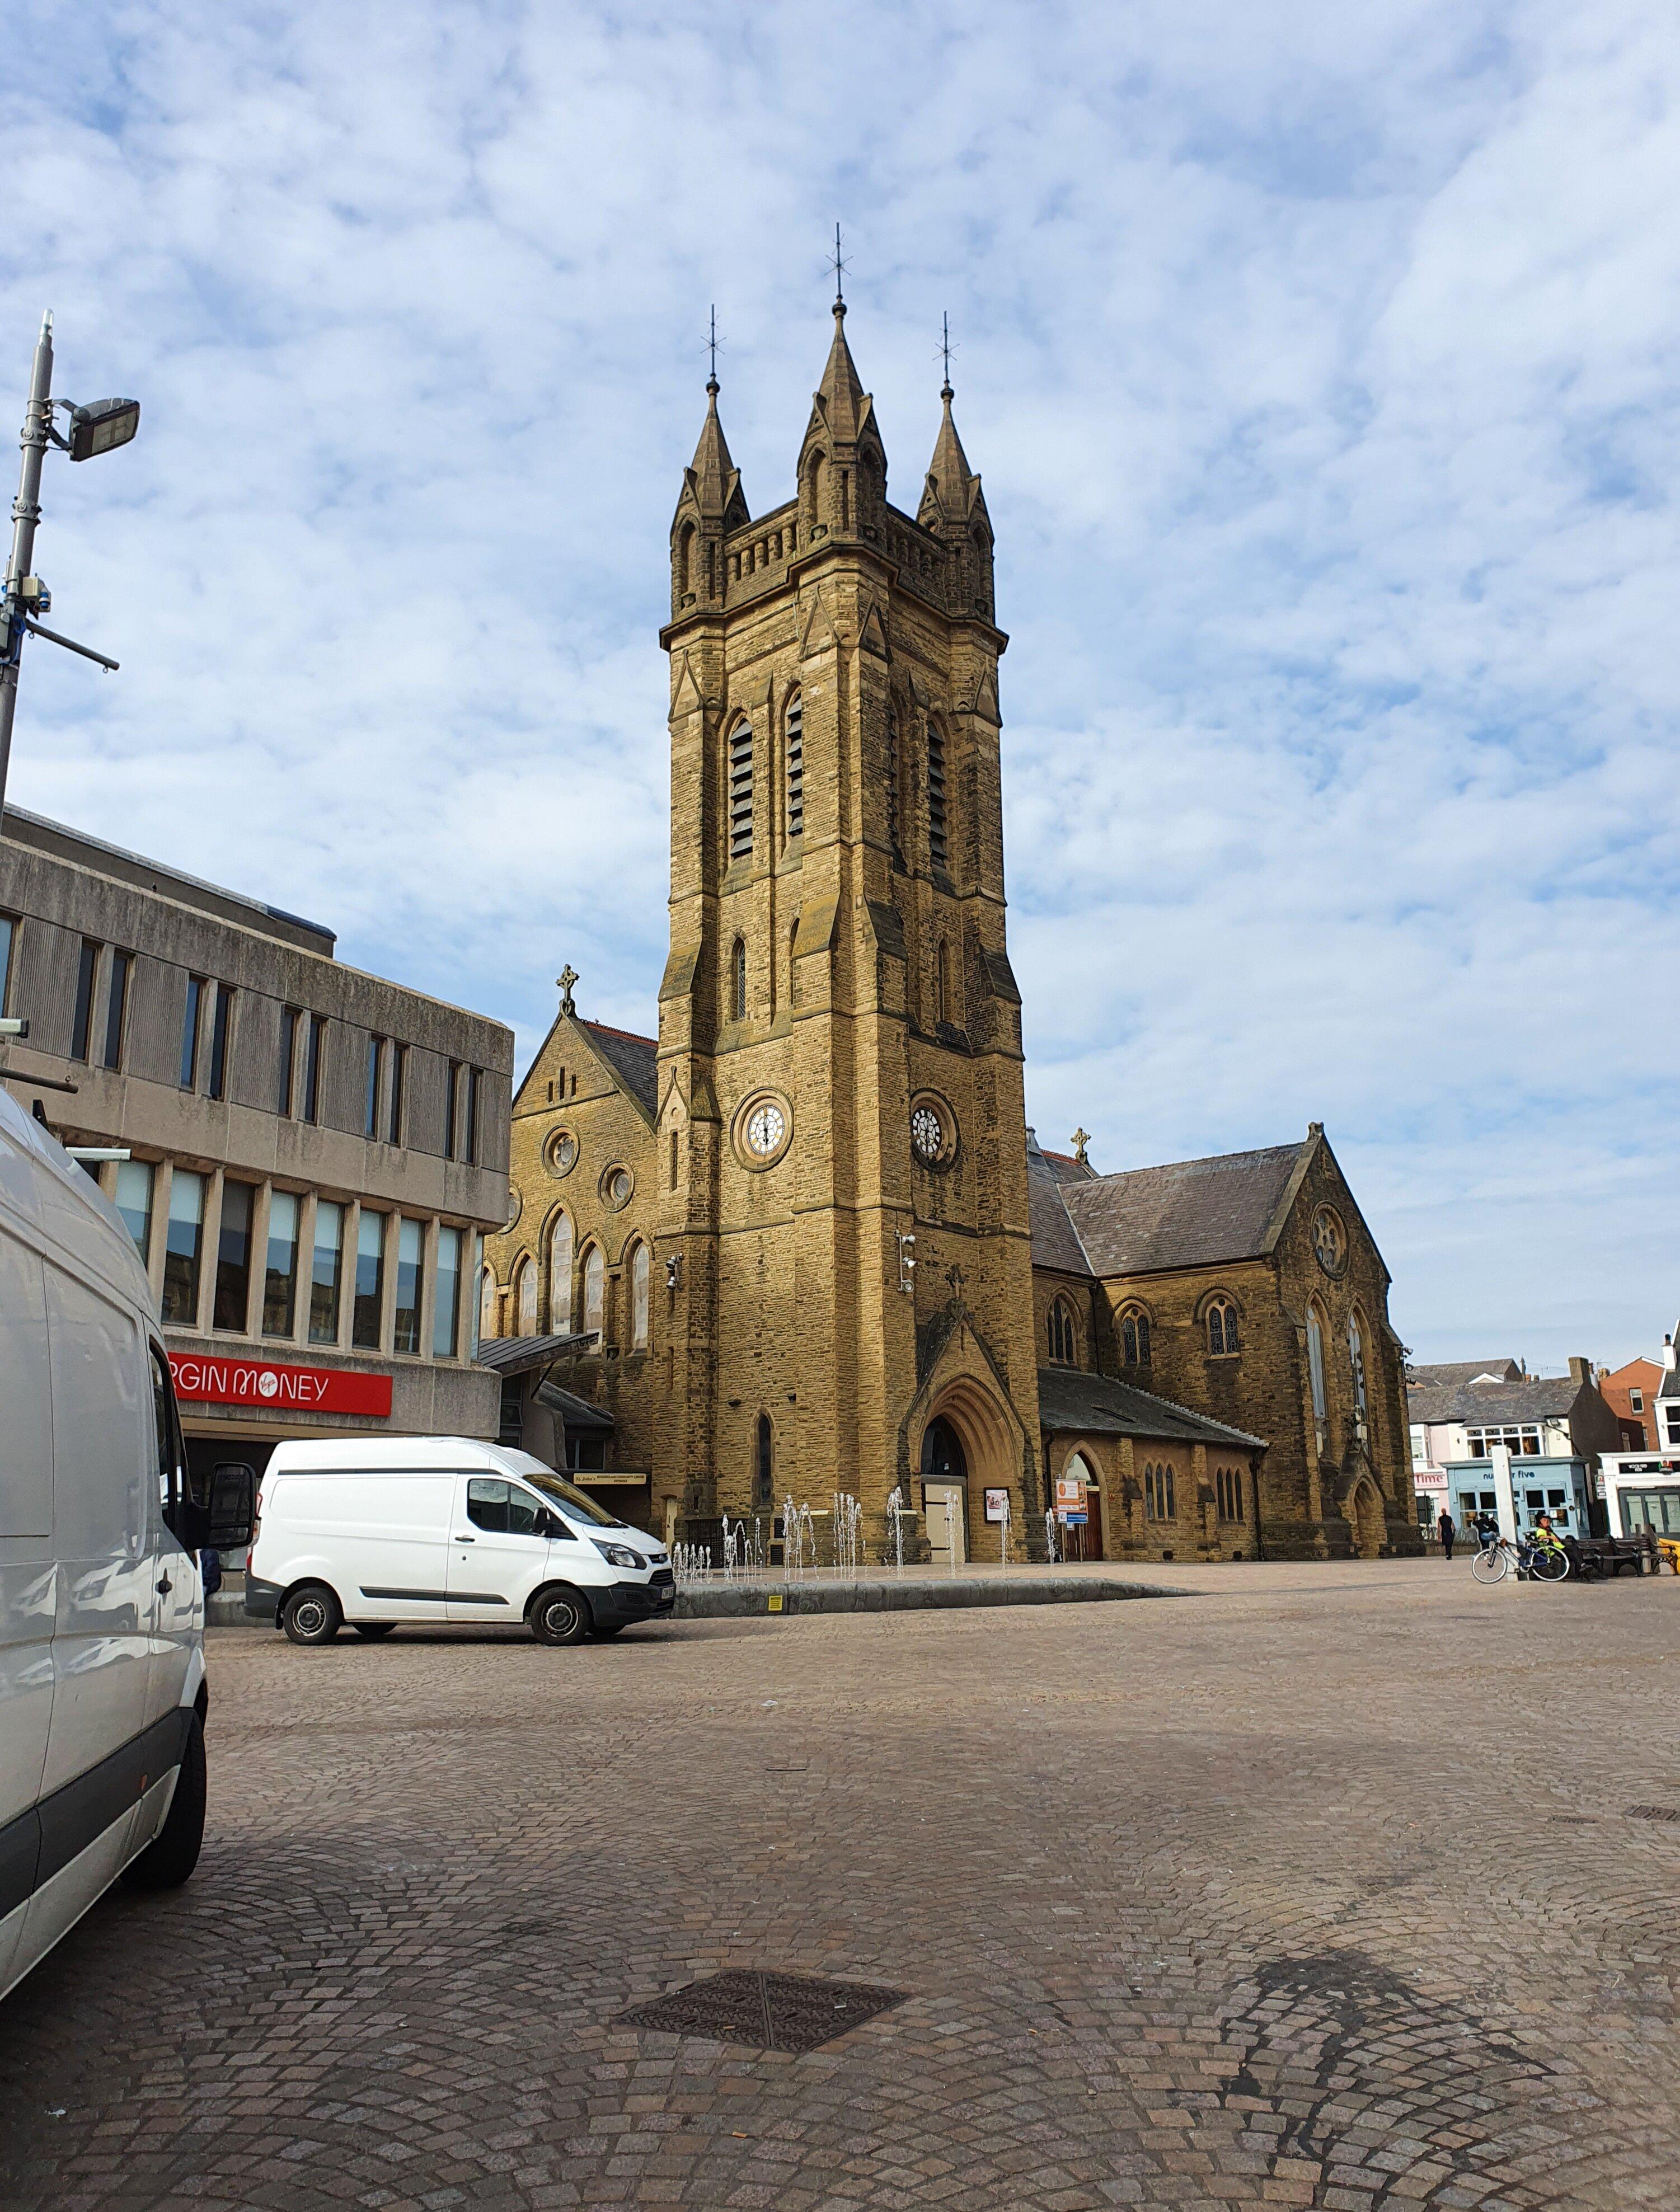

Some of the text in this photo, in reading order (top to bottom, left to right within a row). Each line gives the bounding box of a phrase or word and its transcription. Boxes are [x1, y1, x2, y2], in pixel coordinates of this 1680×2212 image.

[169, 1361, 329, 1401] RGIN MONEY
[1415, 1474, 1443, 1483] Time
[1518, 1470, 1535, 1478] five
